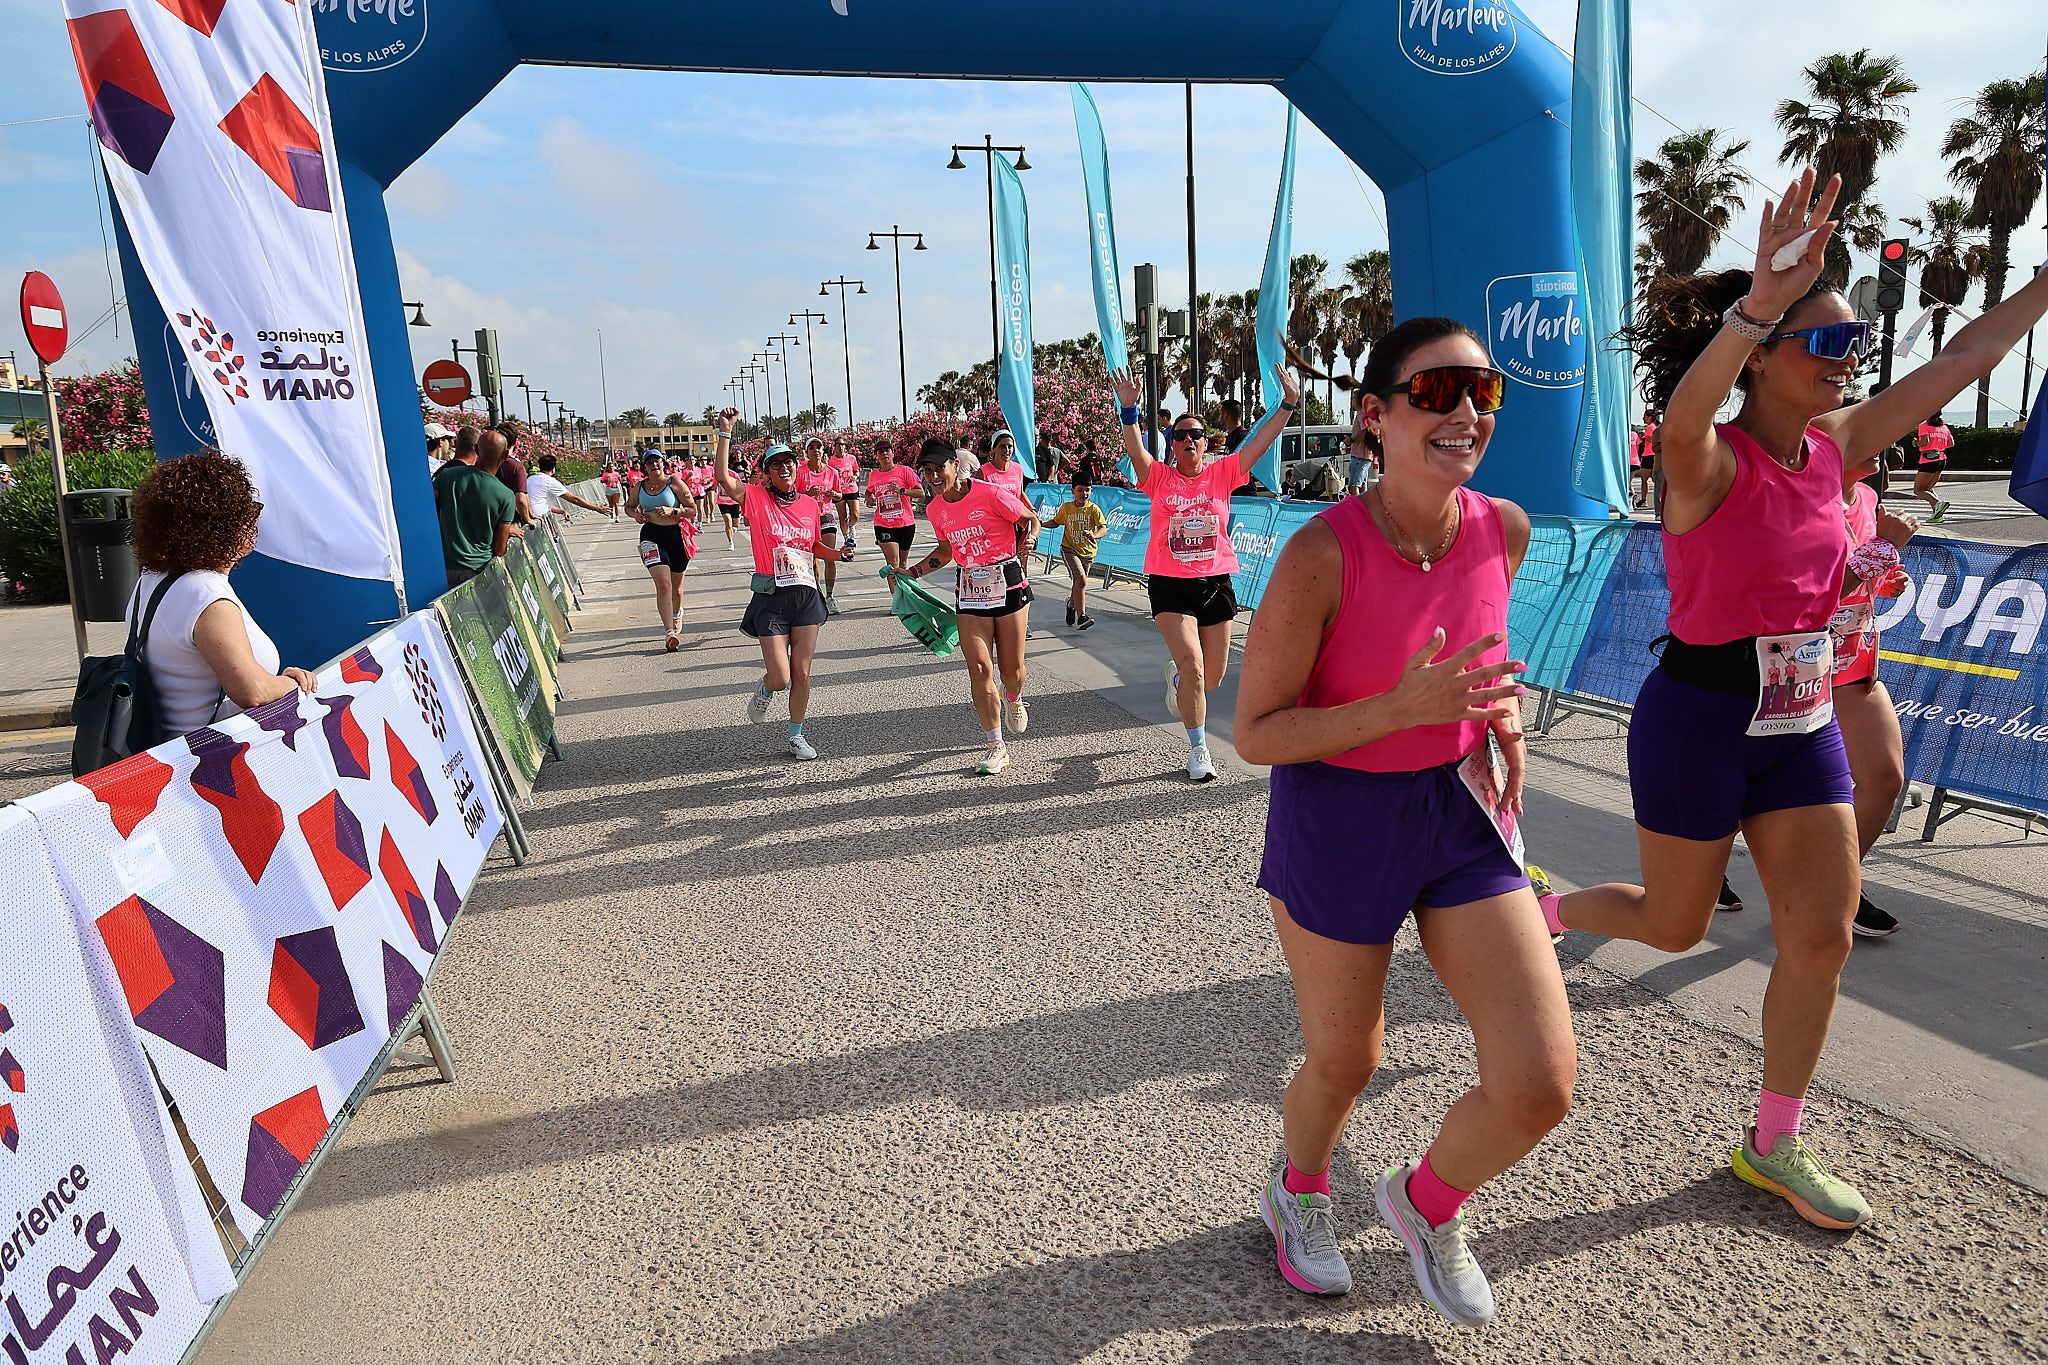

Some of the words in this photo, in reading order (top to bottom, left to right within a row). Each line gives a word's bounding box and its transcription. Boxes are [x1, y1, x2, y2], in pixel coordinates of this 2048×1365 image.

[1409, 0, 1507, 46] Marlene
[334, 51, 362, 63] LOS
[367, 39, 406, 62] ALPES
[1413, 45, 1435, 64] HIJA
[1437, 57, 1452, 68] DE
[1455, 57, 1475, 68] LOS
[1478, 42, 1506, 64] ALPES
[1500, 298, 1584, 358] Marle
[1508, 358, 1532, 377] HIJA
[1536, 371, 1551, 381] DE
[1554, 373, 1572, 381] LOS
[1106, 505, 1151, 530] Compeed
[771, 523, 812, 541] CARRERA
[946, 525, 986, 544] CARRERA
[1184, 537, 1204, 546] 016
[1230, 522, 1279, 560] Compeed
[973, 585, 992, 594] 016
[1866, 571, 2047, 655] OYA
[1794, 677, 1824, 700] 016
[1760, 722, 1796, 731] OYSHO
[1944, 708, 1997, 730] ser
[1997, 705, 2048, 743] bue
[463, 795, 487, 839] OMAN
[0, 1163, 90, 1290] erience
